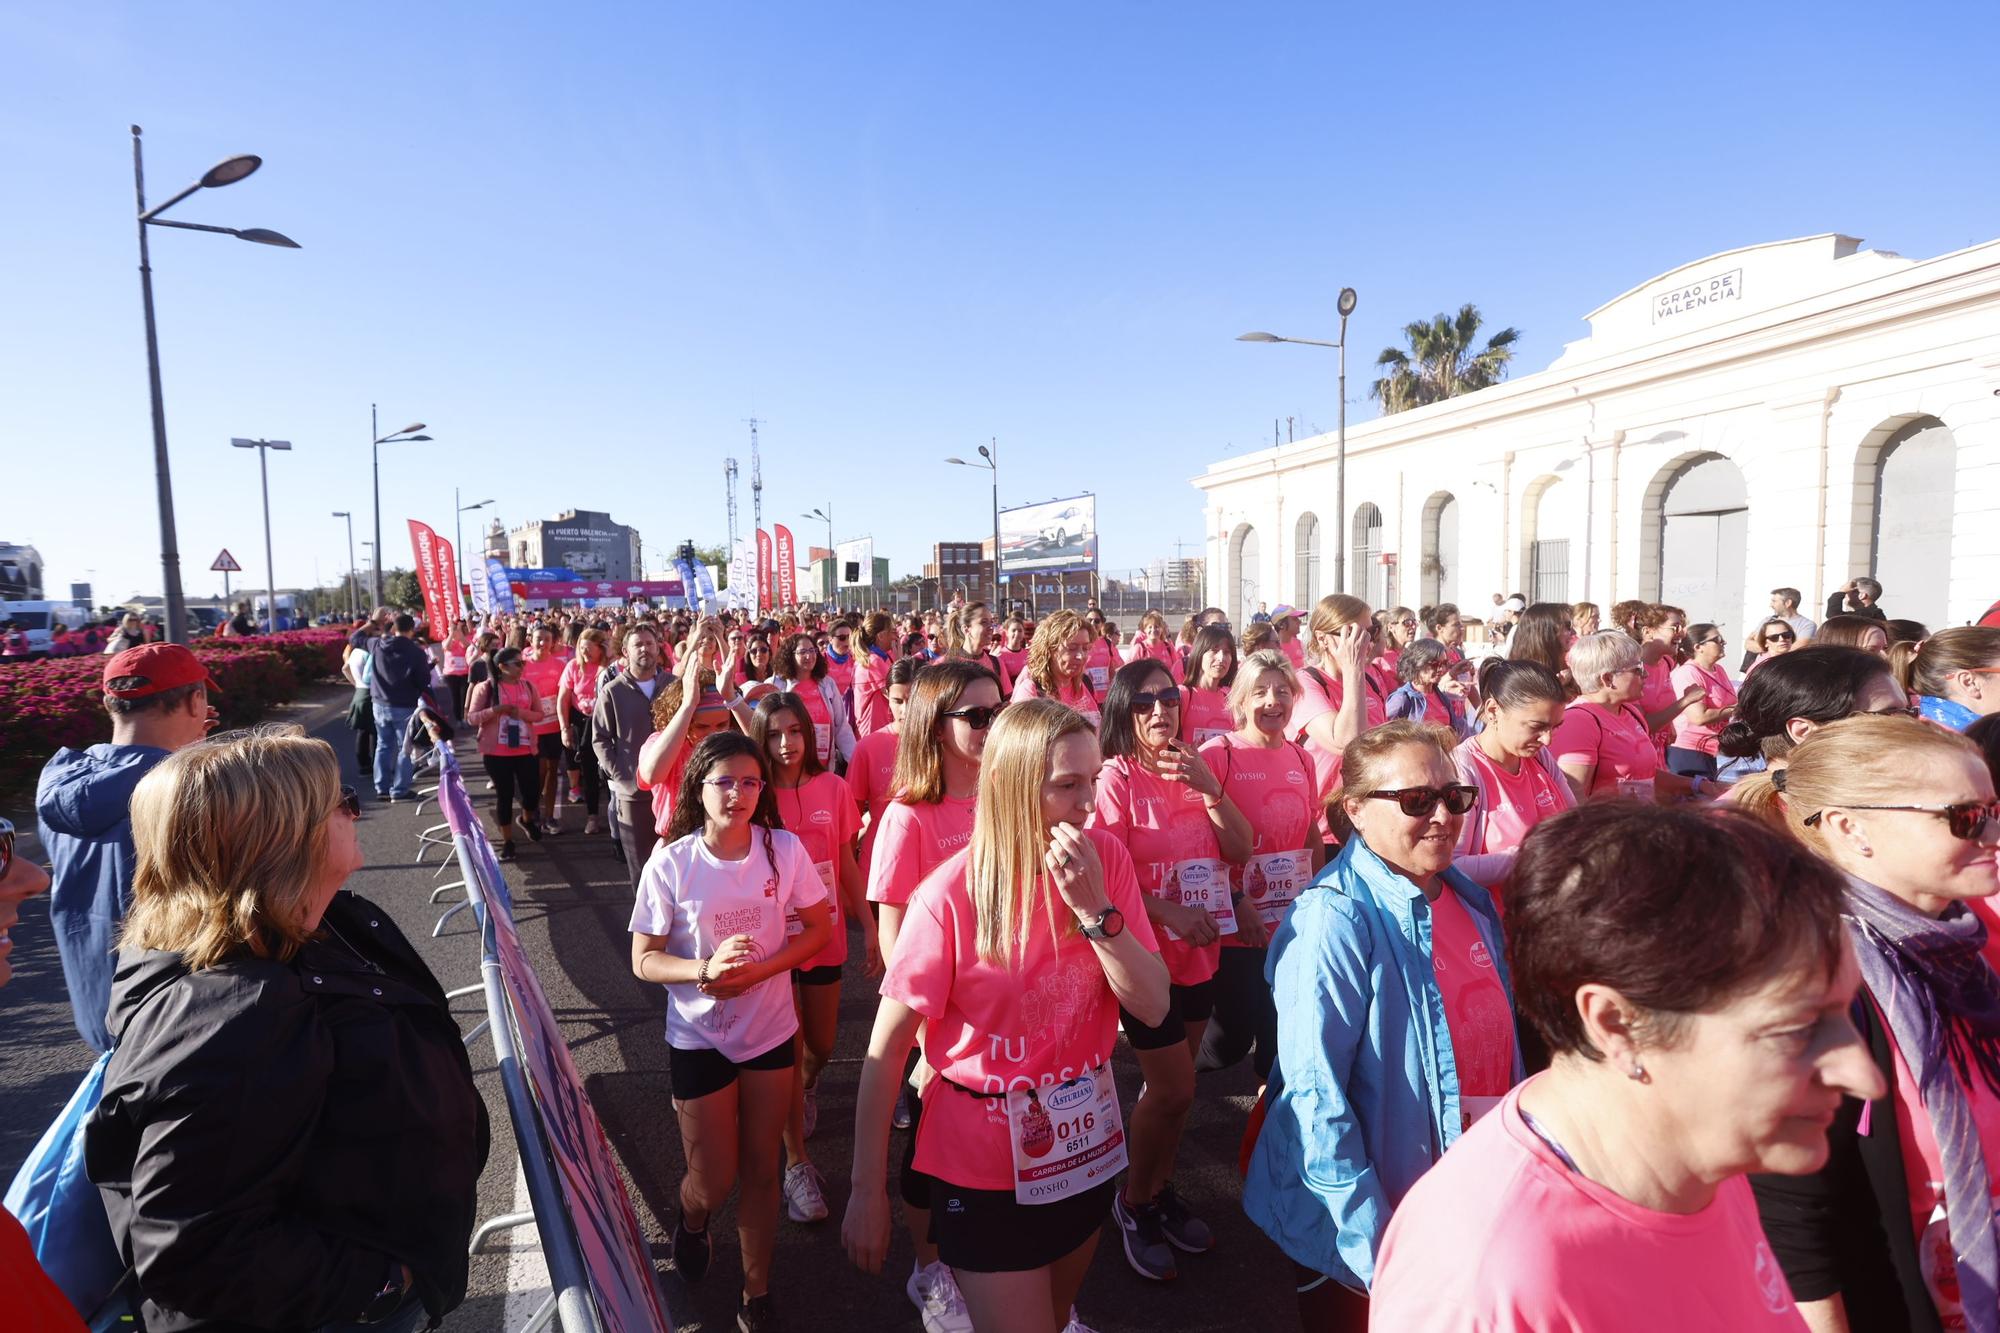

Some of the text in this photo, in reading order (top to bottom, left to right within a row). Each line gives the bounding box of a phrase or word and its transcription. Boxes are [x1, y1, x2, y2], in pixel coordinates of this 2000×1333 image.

[1660, 275, 1733, 306] GRAO DE
[1658, 287, 1735, 318] VALENCIA
[555, 528, 580, 536] PUERTO
[1234, 771, 1266, 781] OYSHO
[1269, 879, 1292, 890] 016
[1184, 888, 1209, 901] 016
[723, 906, 761, 920] CAMPUS
[713, 921, 762, 937] PROMESAS
[714, 914, 761, 930] ATLETISMO
[987, 1033, 1026, 1063] TU
[1057, 1111, 1095, 1140] 016
[1066, 1135, 1090, 1153] 6511
[1032, 1163, 1067, 1178] CARRERA
[1068, 1159, 1078, 1168] DE
[1078, 1155, 1088, 1164] LA
[1087, 1145, 1107, 1159] MUJER
[1029, 1178, 1069, 1197] OYSHO
